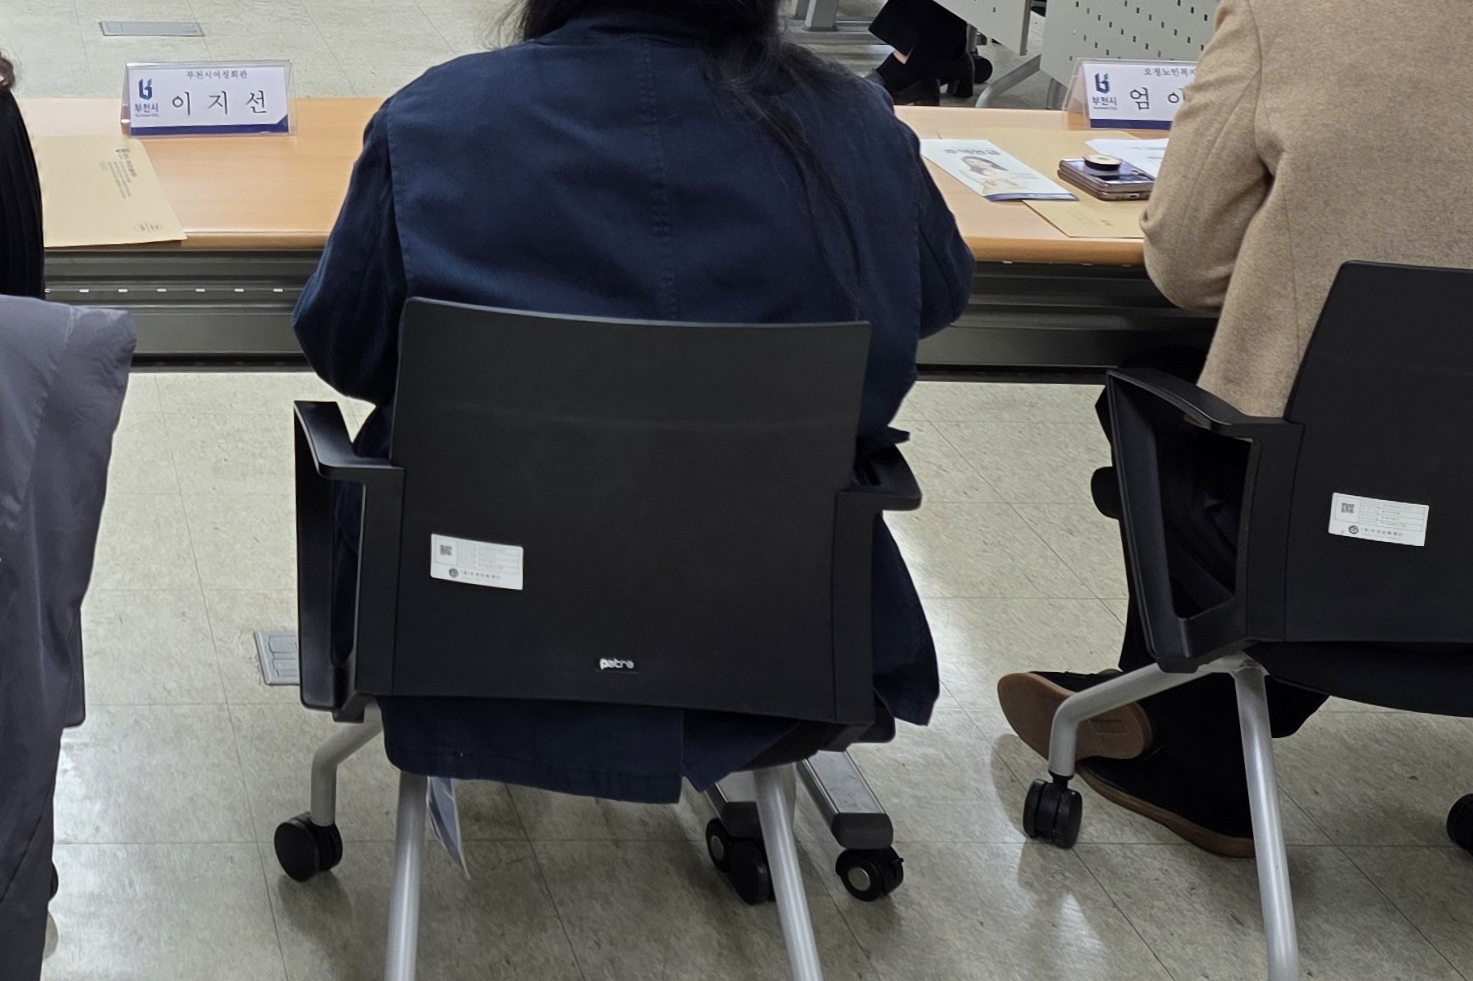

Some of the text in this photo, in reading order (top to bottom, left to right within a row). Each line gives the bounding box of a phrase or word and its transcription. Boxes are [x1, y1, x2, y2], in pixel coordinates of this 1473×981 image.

[185, 69, 248, 80] 부천시여성회관
[1091, 96, 1118, 107] 부천시
[134, 103, 160, 114] 부천시
